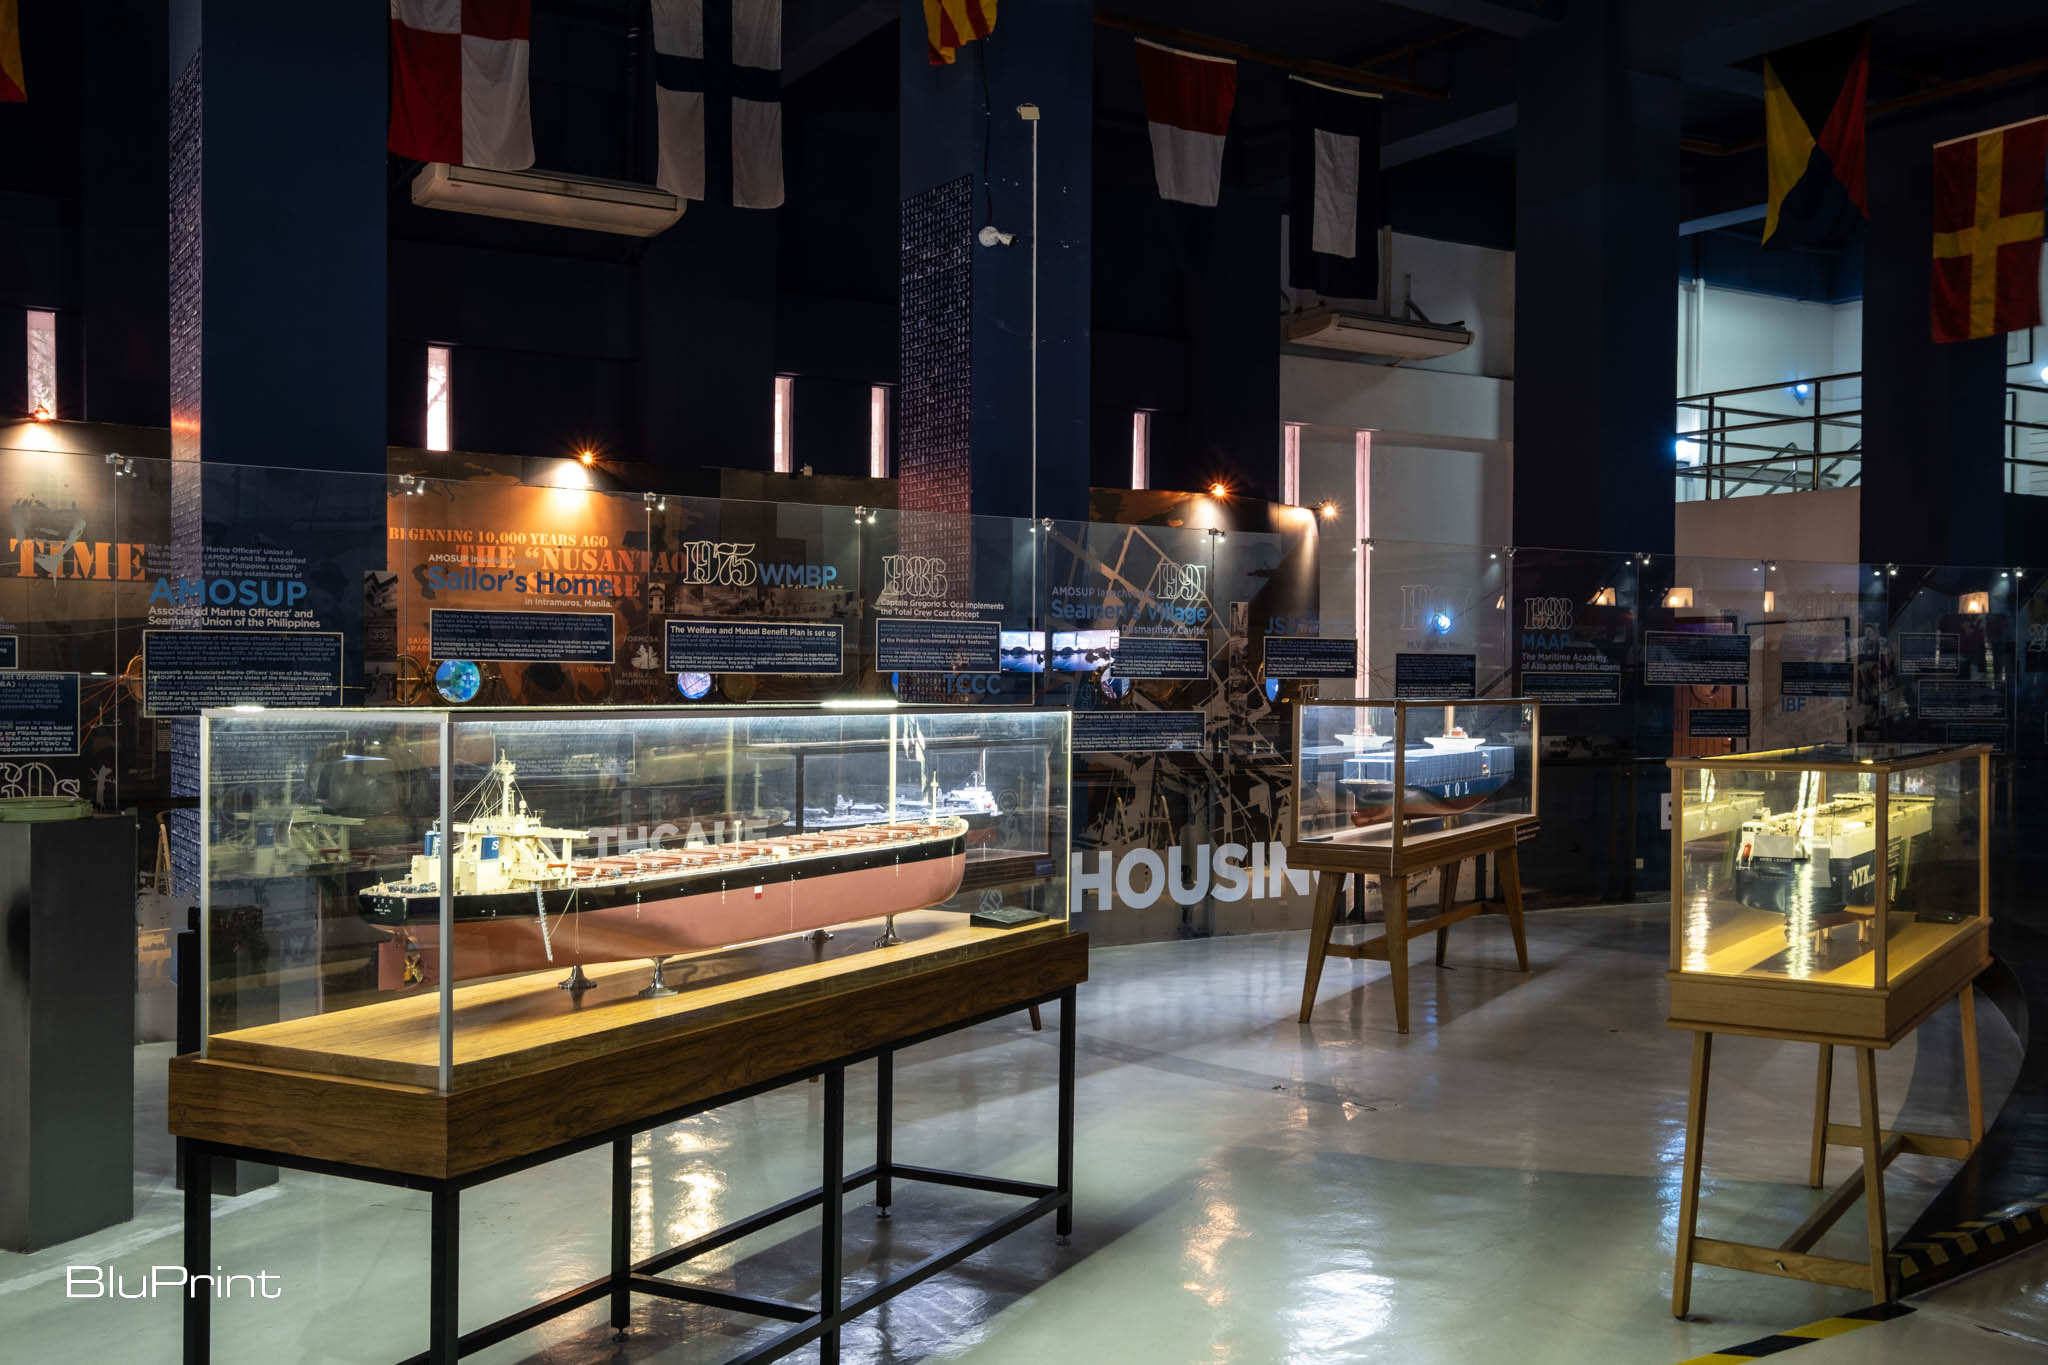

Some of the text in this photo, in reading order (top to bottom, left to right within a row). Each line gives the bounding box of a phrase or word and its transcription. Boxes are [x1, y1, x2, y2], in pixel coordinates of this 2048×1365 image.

[389, 527, 608, 549] BEGINNING 10,000 YEARS AGO
[205, 546, 230, 555] Marine
[263, 549, 284, 557] Union
[285, 549, 294, 557] of
[456, 545, 517, 569] THE
[240, 555, 253, 563] and
[268, 556, 306, 565] Associated
[682, 539, 758, 588] 1975
[217, 562, 229, 570] the
[231, 562, 270, 573] Philippines
[758, 562, 838, 588] WMBP
[881, 555, 948, 598] 1986
[536, 571, 614, 598] Home
[149, 577, 307, 607] AMOSUP
[1052, 586, 1094, 598] AMOSUP
[525, 598, 533, 606] in
[535, 598, 582, 609] Intramuros,
[881, 599, 908, 609] Captain
[909, 600, 940, 610] Gregorio
[950, 602, 964, 610] Oca
[148, 607, 208, 620] Associated
[211, 609, 246, 620] Marine
[294, 610, 313, 622] and
[880, 607, 980, 621] the Total Crew Cost Concept
[1146, 602, 1208, 626] Village
[202, 617, 232, 628] Union
[234, 617, 245, 628] of
[248, 618, 264, 628] the
[266, 618, 321, 631] Philippines
[670, 626, 685, 635] The
[686, 627, 718, 635] Welfare
[735, 627, 760, 636] Mutual
[761, 628, 788, 636] Benefit
[789, 629, 805, 637] Plan
[827, 631, 837, 639] up
[1521, 632, 1570, 650] MAAP
[1522, 654, 1536, 662] The
[1539, 653, 1571, 663] Maritime
[1532, 663, 1546, 671] Asia
[1071, 842, 1319, 913] HOUSIN
